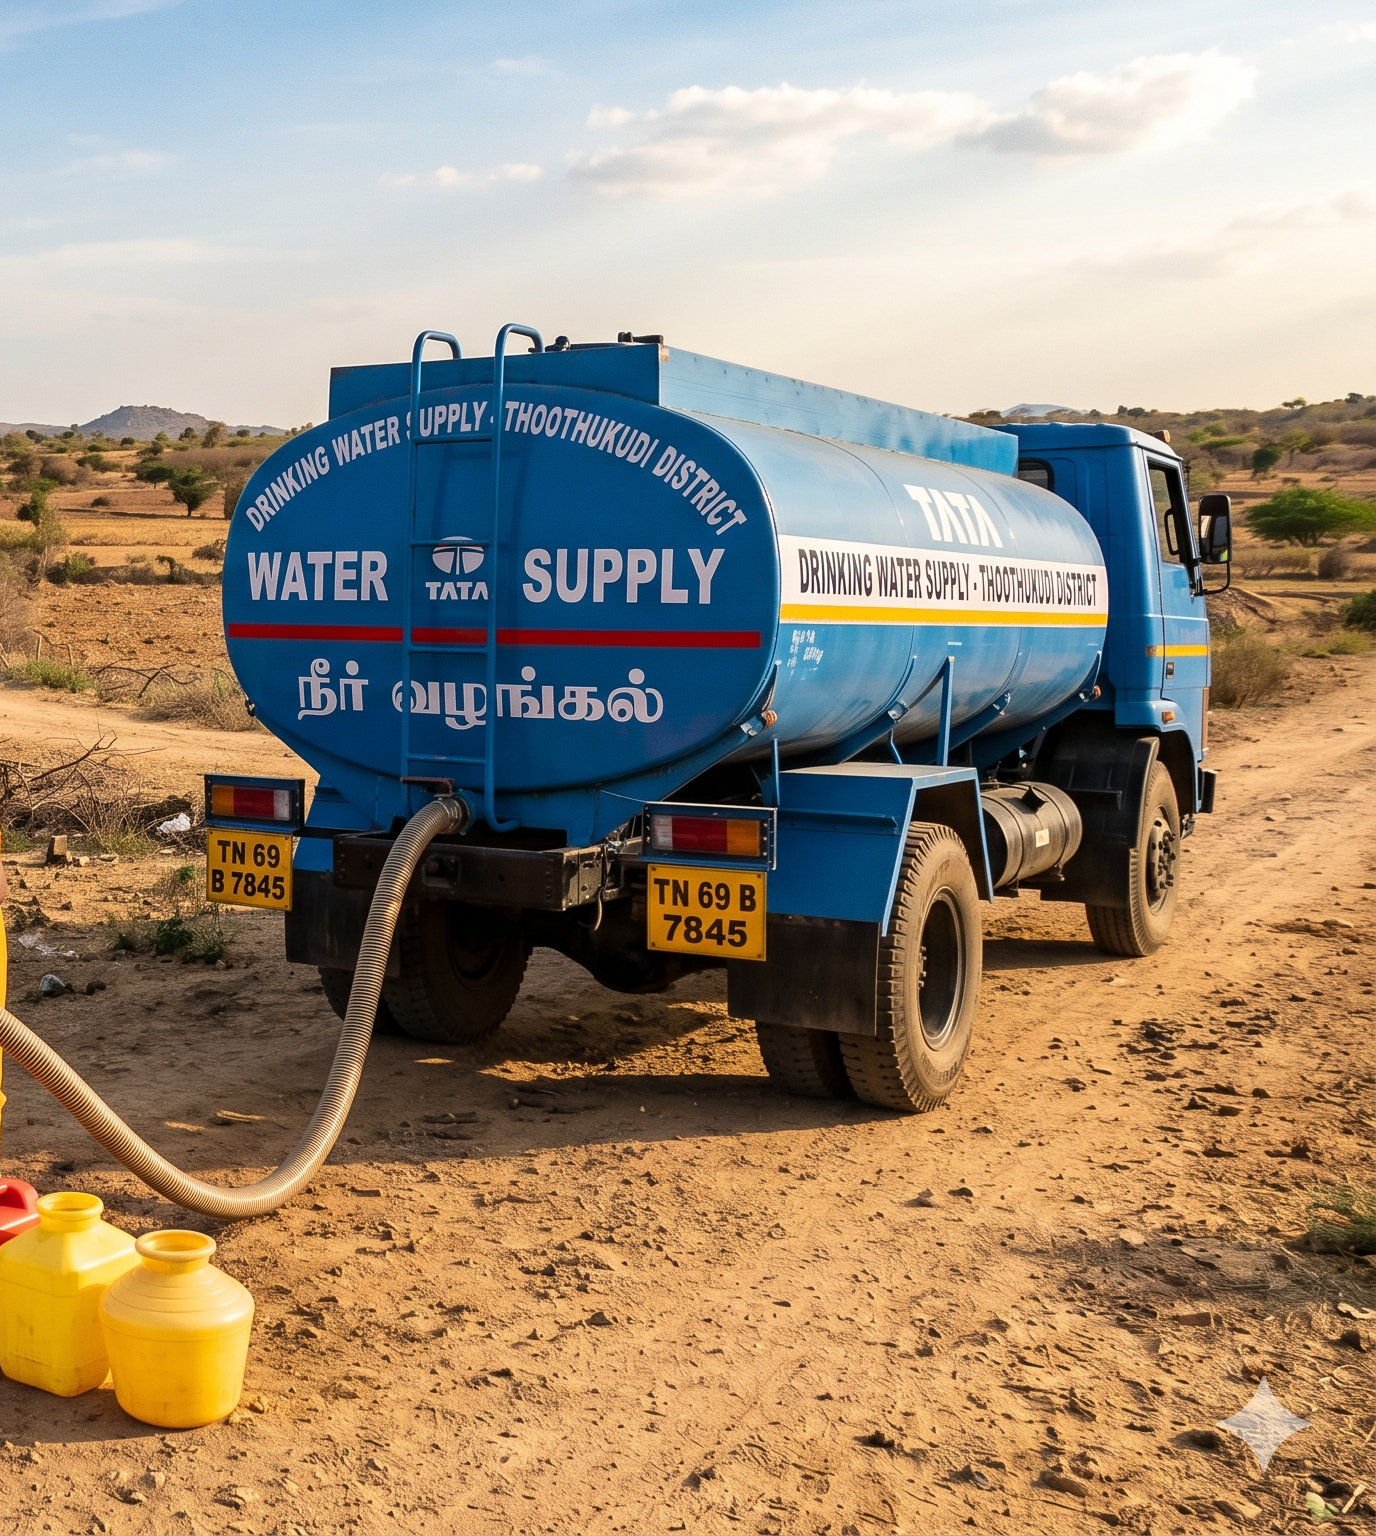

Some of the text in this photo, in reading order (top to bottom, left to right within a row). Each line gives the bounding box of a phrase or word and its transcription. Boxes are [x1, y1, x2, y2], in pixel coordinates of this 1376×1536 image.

[245, 446, 330, 532] DRINKING
[331, 415, 401, 467] WATER
[504, 400, 660, 468] THOOTHUKUDI
[652, 445, 748, 536] DISTRICT
[902, 483, 1004, 549] TATA
[247, 548, 726, 605] WATER SUPPLY
[425, 581, 489, 600] TATA
[798, 548, 873, 597] DRINKING
[875, 555, 922, 599] WATER
[925, 559, 970, 601] SUPPLY
[978, 564, 1055, 605] THOOTHUKUDI
[1056, 571, 1097, 607] DISTRICT
[297, 658, 664, 730] நீர் வழங்கல்
[217, 839, 280, 869] TN 69
[211, 868, 285, 901] B 7845
[653, 878, 757, 912] TN 69 B
[663, 913, 748, 948] 7845
